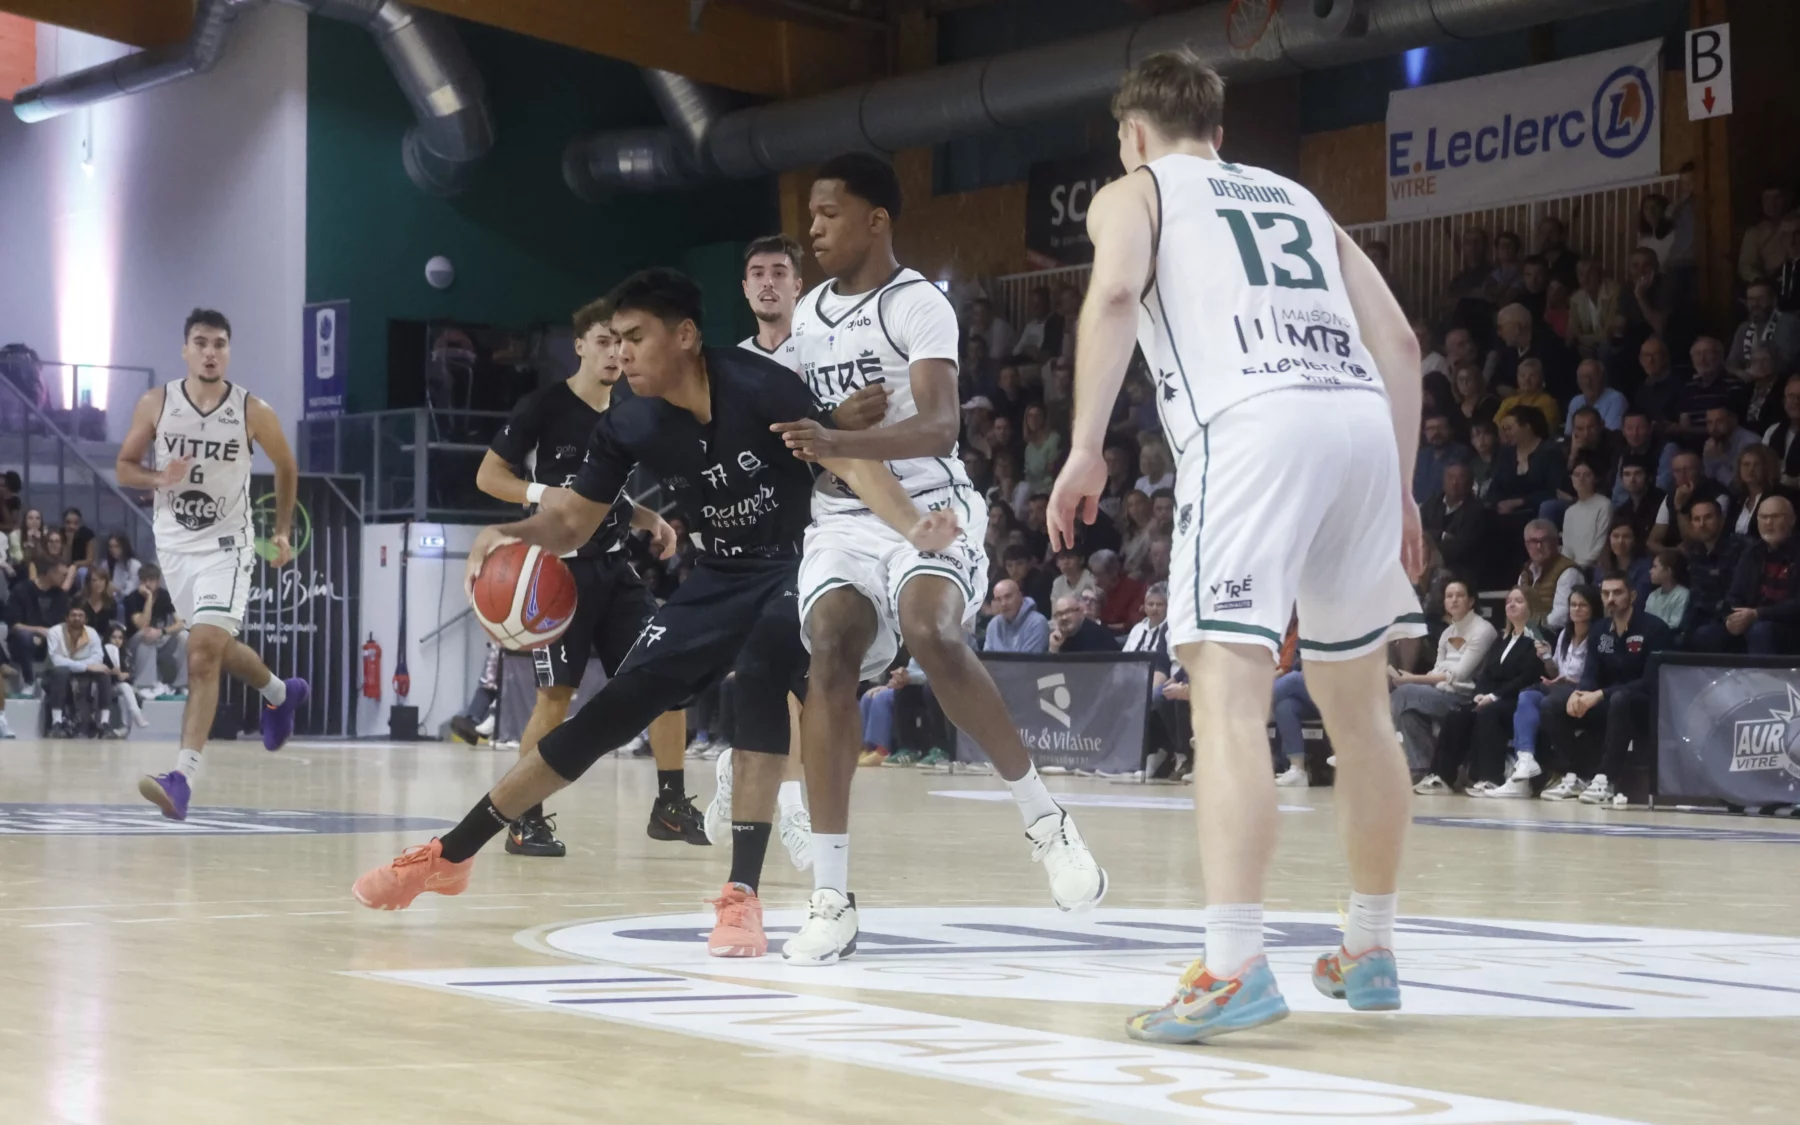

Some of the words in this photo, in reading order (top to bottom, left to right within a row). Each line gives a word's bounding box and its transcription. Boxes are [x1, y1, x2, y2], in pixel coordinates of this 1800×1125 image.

[1691, 29, 1724, 85] B
[1389, 109, 1585, 177] E.Leclerc
[1207, 177, 1295, 206] DEBRUHL
[1390, 176, 1437, 200] VITRE
[1215, 208, 1329, 292] 13
[1284, 323, 1351, 358] MTB
[190, 464, 204, 484] 6
[701, 463, 728, 489] 77
[167, 490, 227, 521] lactel
[1210, 574, 1253, 599] VTRÉ
[1053, 731, 1102, 751] Vilaine
[652, 1008, 1576, 1125] MAISO
